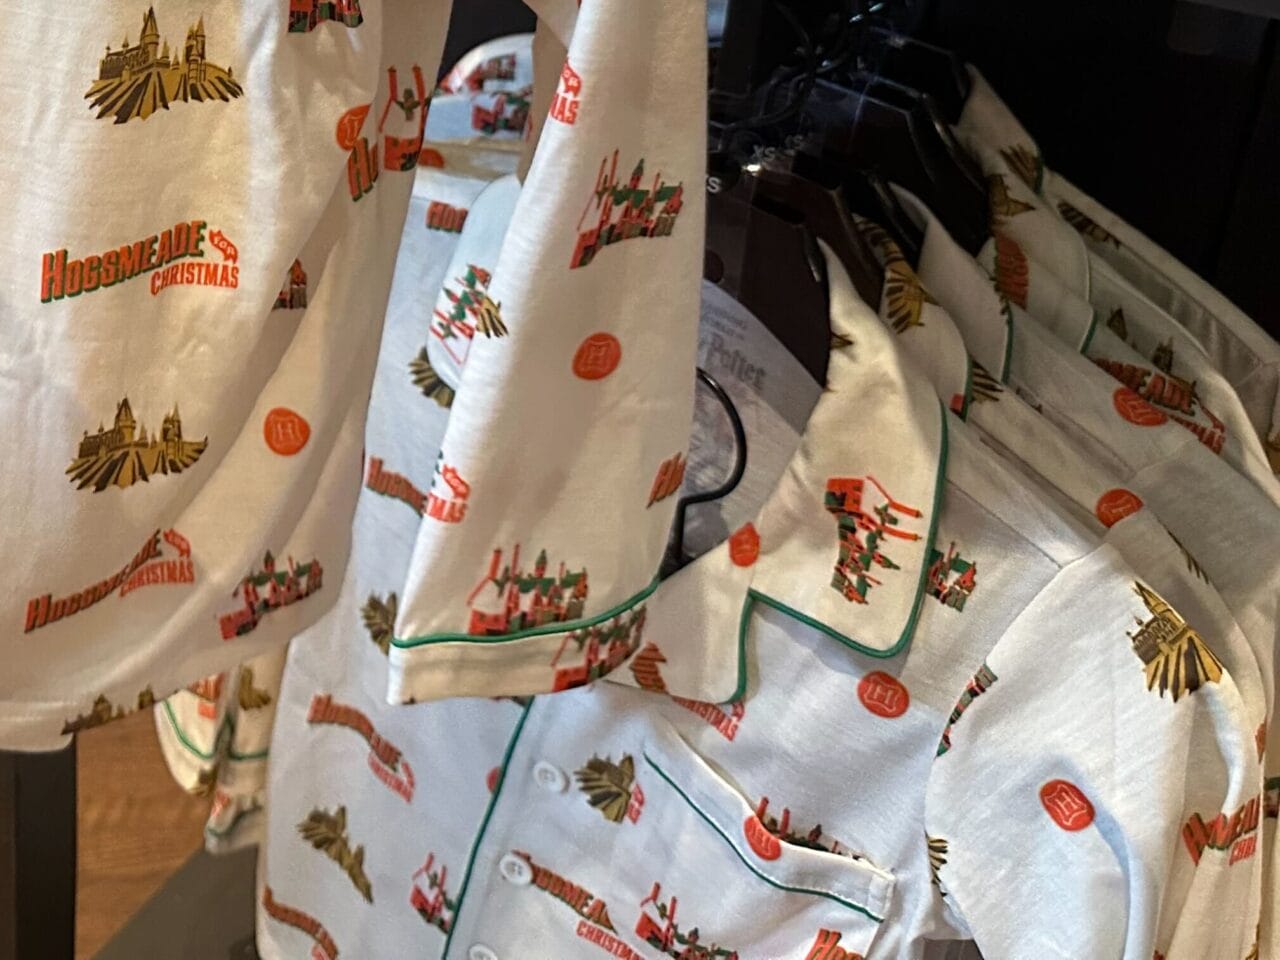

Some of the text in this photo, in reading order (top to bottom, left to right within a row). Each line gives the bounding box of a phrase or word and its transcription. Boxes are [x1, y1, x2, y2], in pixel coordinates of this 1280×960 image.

[40, 220, 208, 304] HOGSMEADE
[150, 261, 240, 297] CHRISTMAS
[576, 919, 645, 959] CHRISTM
